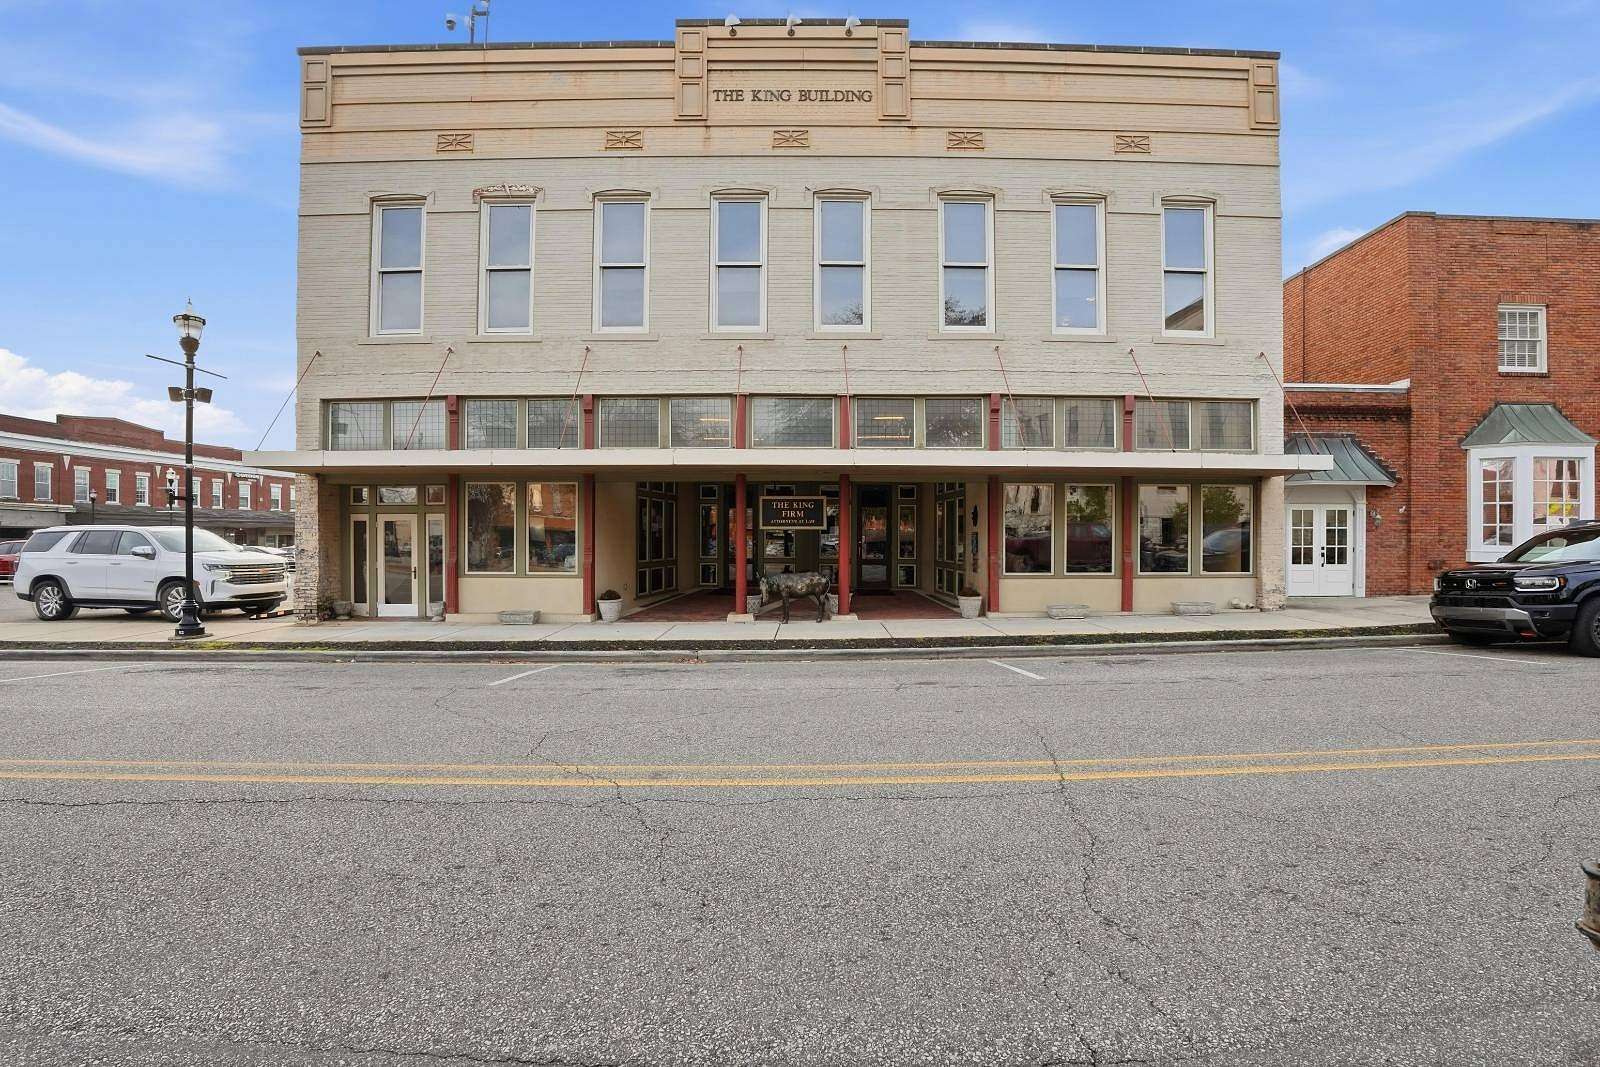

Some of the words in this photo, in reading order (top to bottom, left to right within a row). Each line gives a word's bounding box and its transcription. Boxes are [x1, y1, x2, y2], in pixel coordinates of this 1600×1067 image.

[712, 89, 745, 102] THE
[751, 89, 791, 103] KING
[798, 89, 873, 103] BUILDING
[771, 501, 790, 509] THE
[792, 501, 815, 509] KING
[781, 510, 804, 518] FIRM
